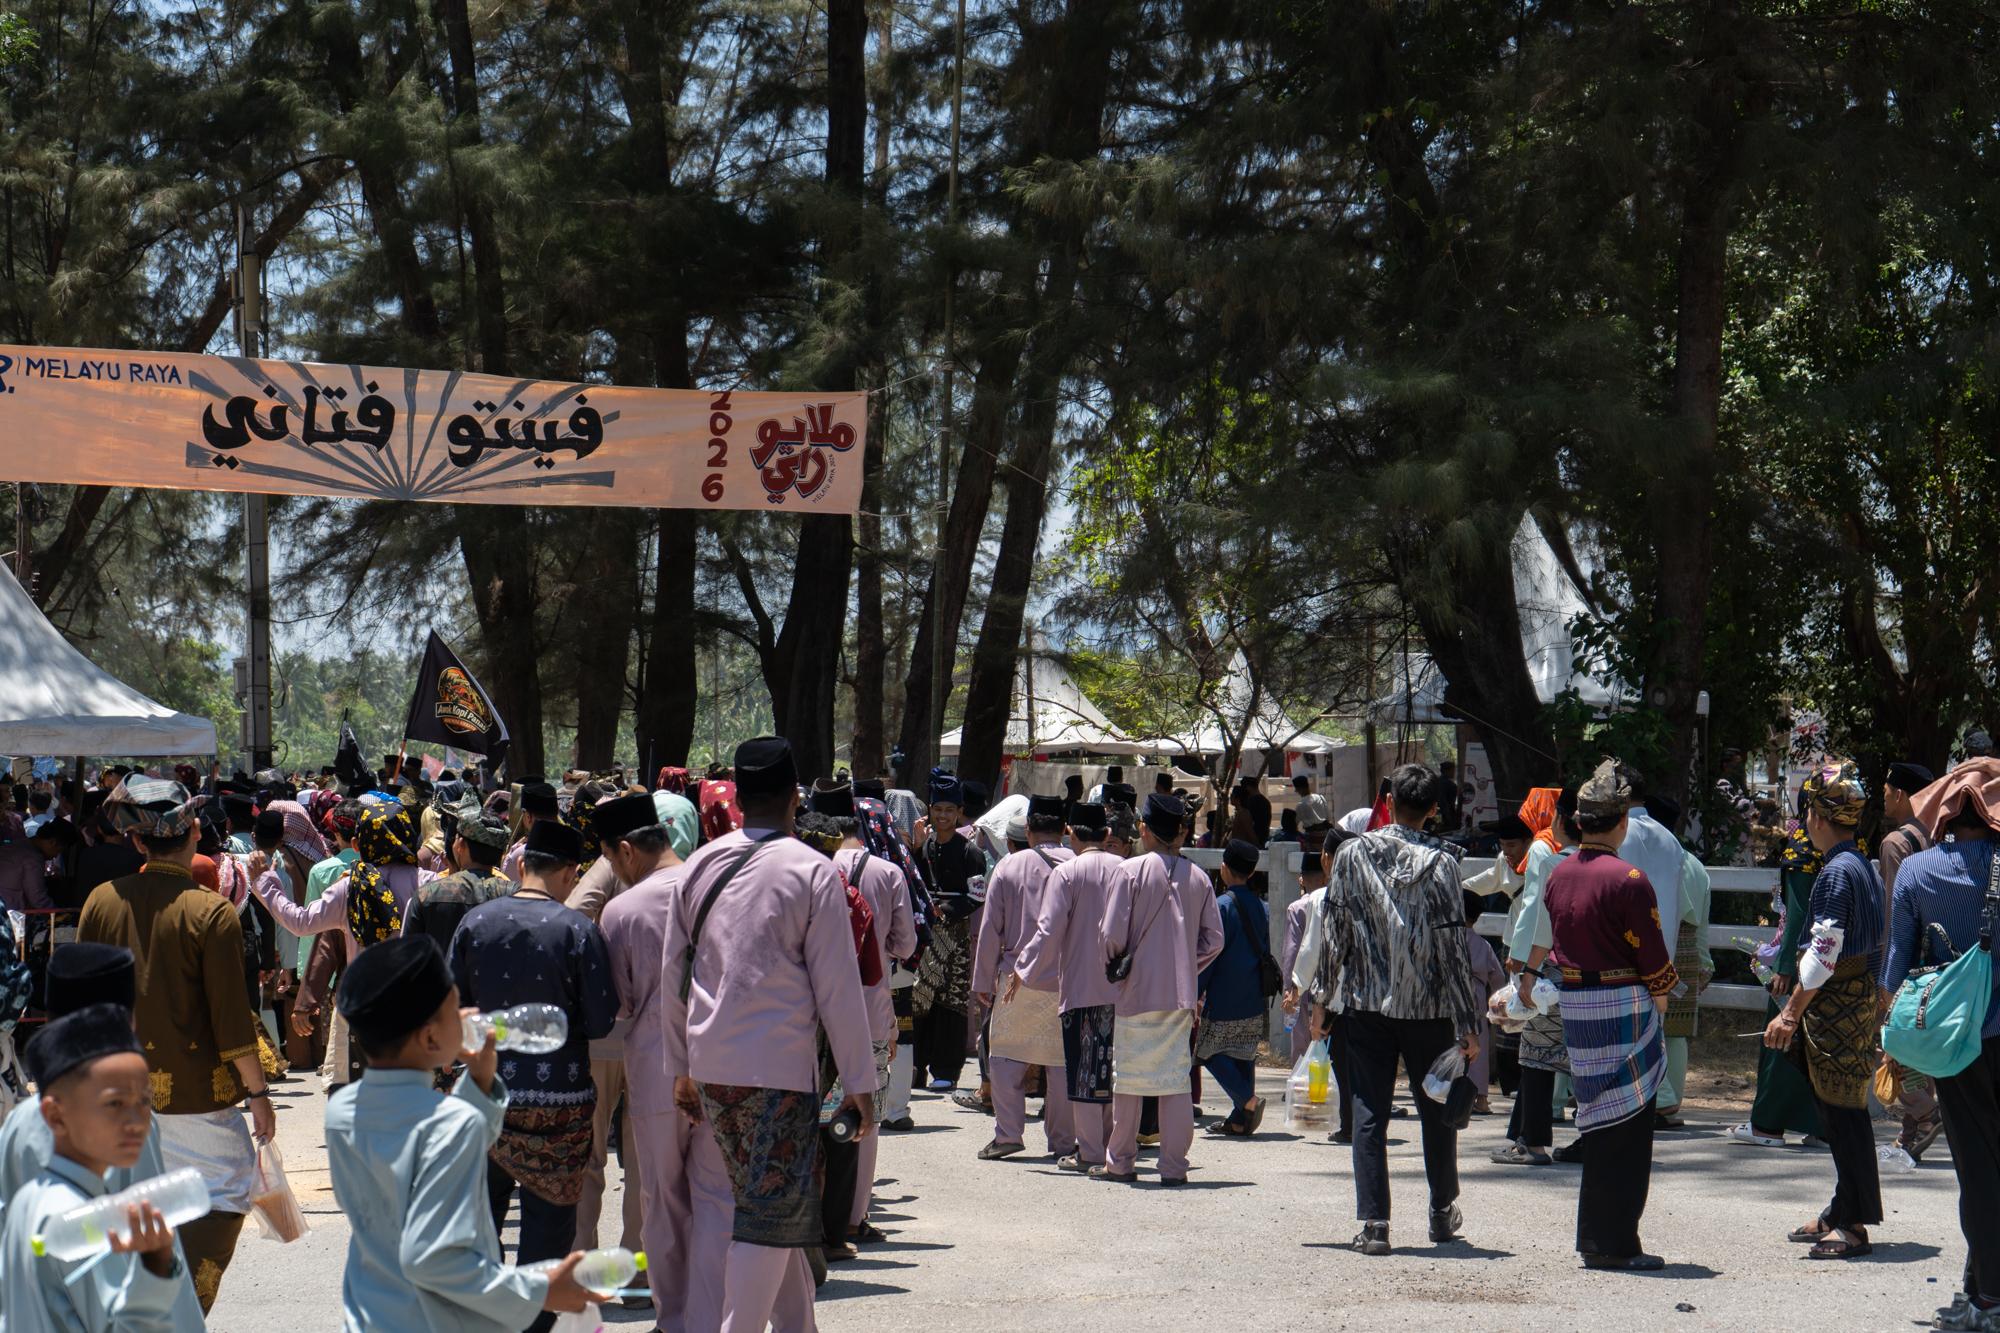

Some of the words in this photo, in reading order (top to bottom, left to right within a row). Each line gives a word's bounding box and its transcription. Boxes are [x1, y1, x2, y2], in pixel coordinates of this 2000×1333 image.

[25, 356, 121, 381] MELAYU
[130, 362, 182, 385] RAYA
[452, 705, 469, 718] Kopi
[467, 712, 487, 730] Panas
